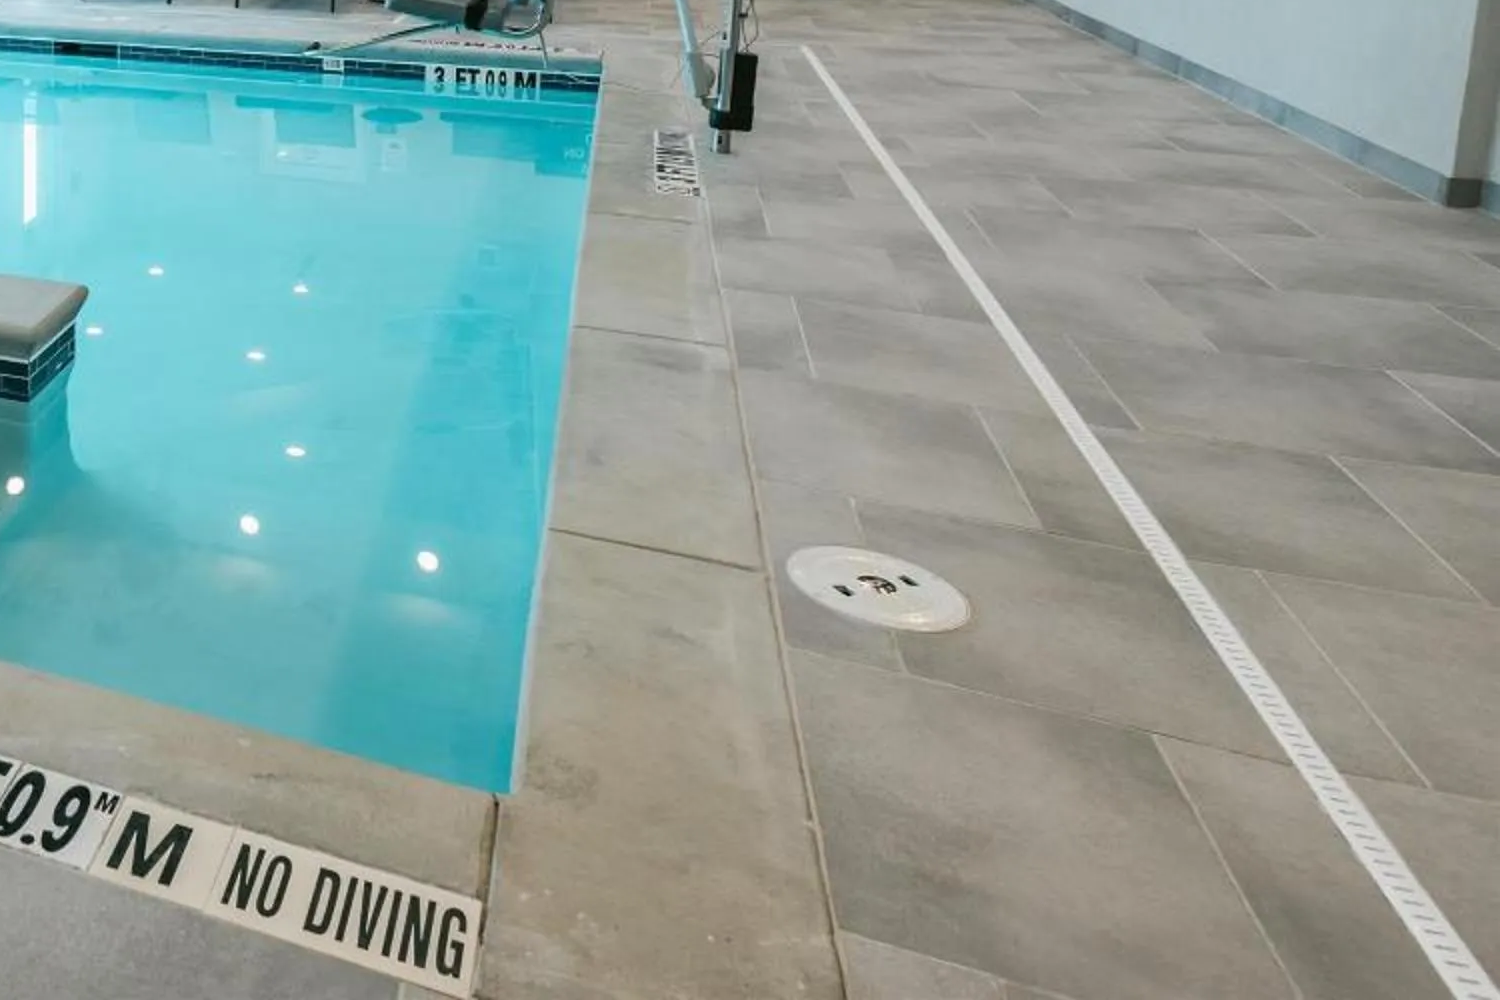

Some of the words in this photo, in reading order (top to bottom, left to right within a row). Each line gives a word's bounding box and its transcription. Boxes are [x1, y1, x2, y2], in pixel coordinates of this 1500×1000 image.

[106, 811, 194, 887] M
[220, 843, 293, 918] NO
[303, 866, 468, 979] DIVING
